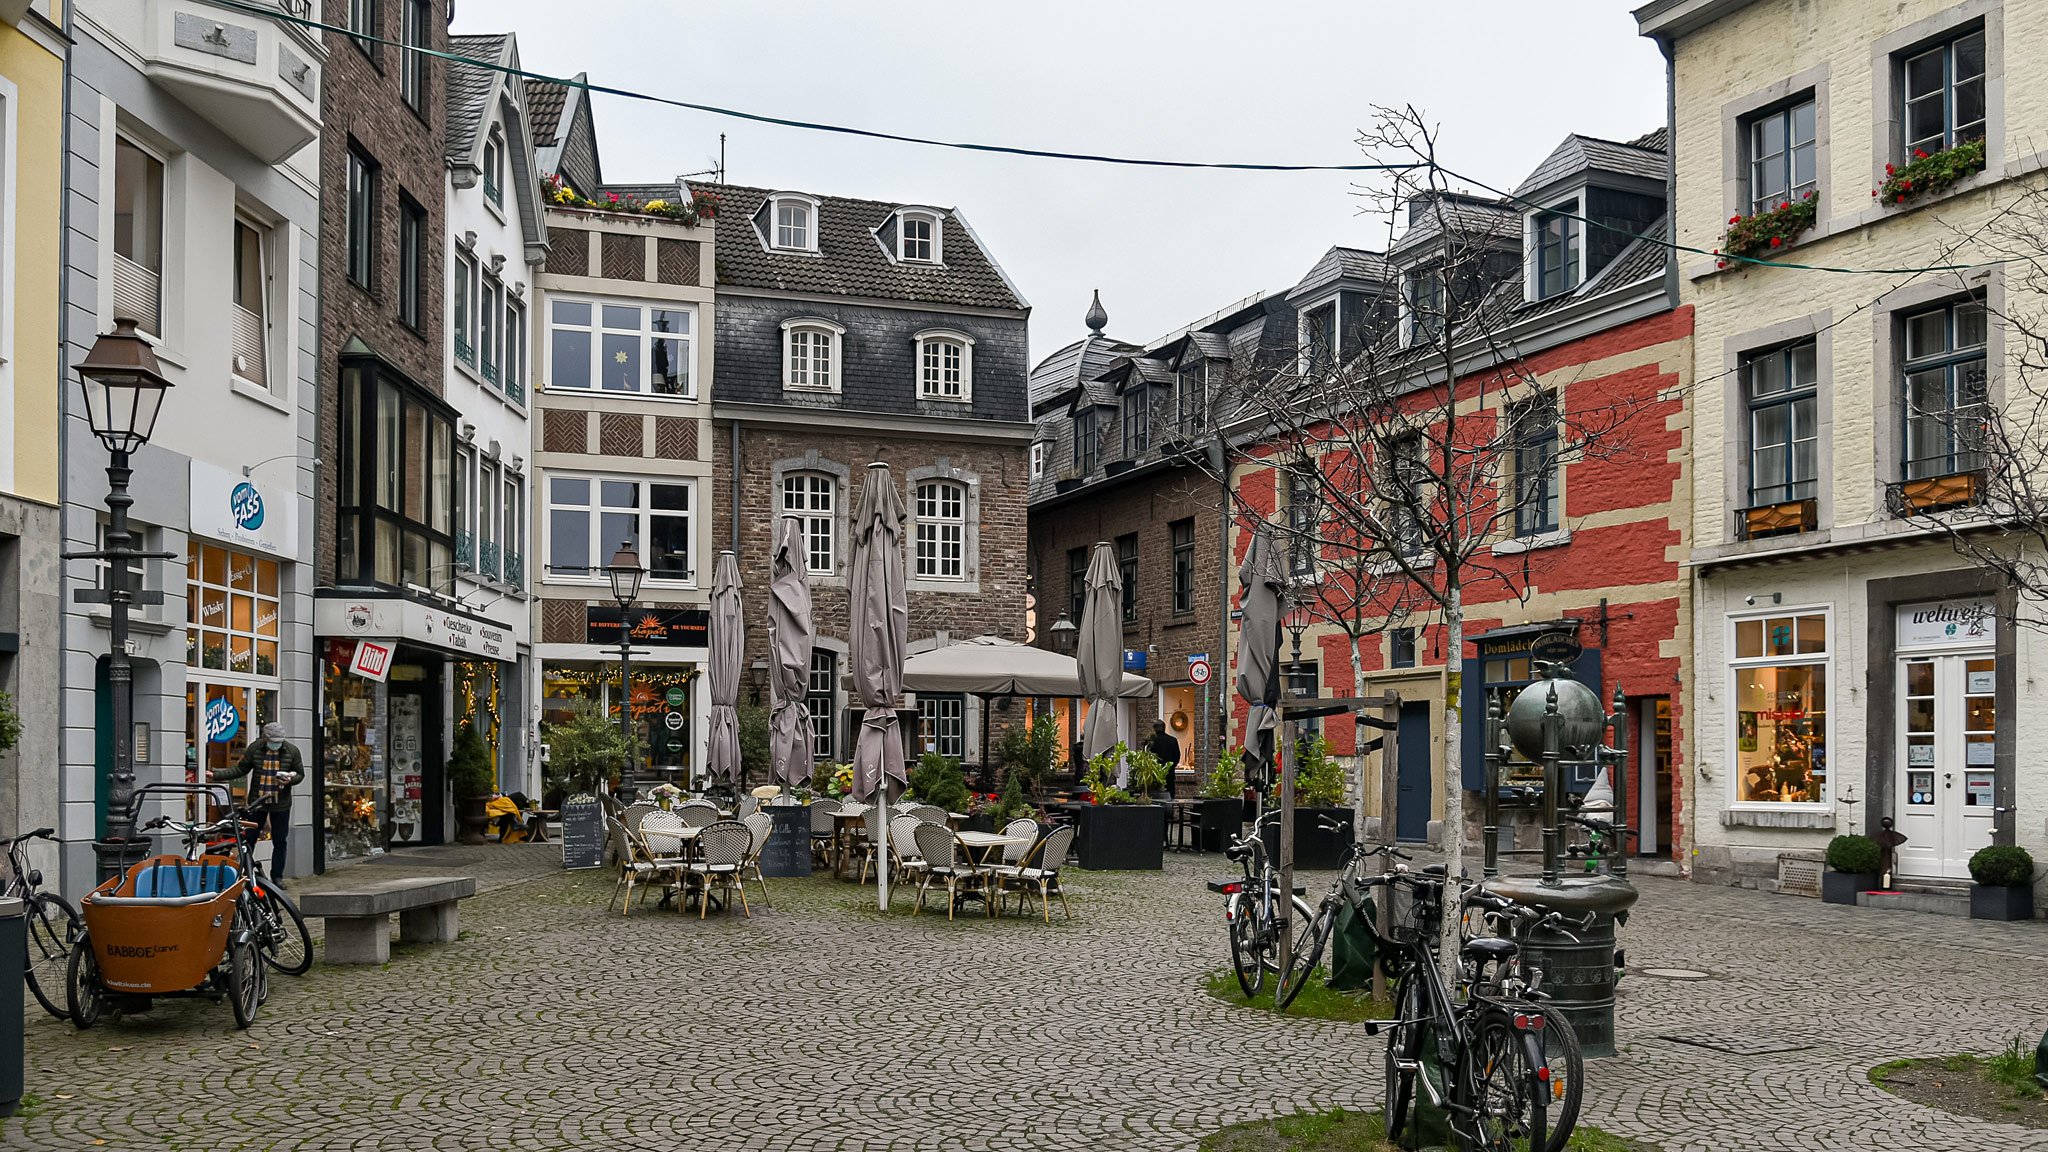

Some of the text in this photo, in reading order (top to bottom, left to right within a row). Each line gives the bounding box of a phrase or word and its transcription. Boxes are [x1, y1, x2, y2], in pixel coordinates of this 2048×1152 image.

[233, 488, 248, 505] vom
[234, 493, 260, 528] FASS
[203, 600, 224, 617] Whisky
[1913, 602, 1984, 625] weltweit
[446, 616, 472, 635] Geschenke
[452, 633, 467, 648] Tabak
[485, 641, 500, 656] Presse
[1484, 639, 1533, 655] Domlädch
[609, 700, 670, 720] capati
[1755, 708, 1804, 720] missio
[205, 706, 234, 743] FASS
[107, 944, 155, 958] BABBOE
